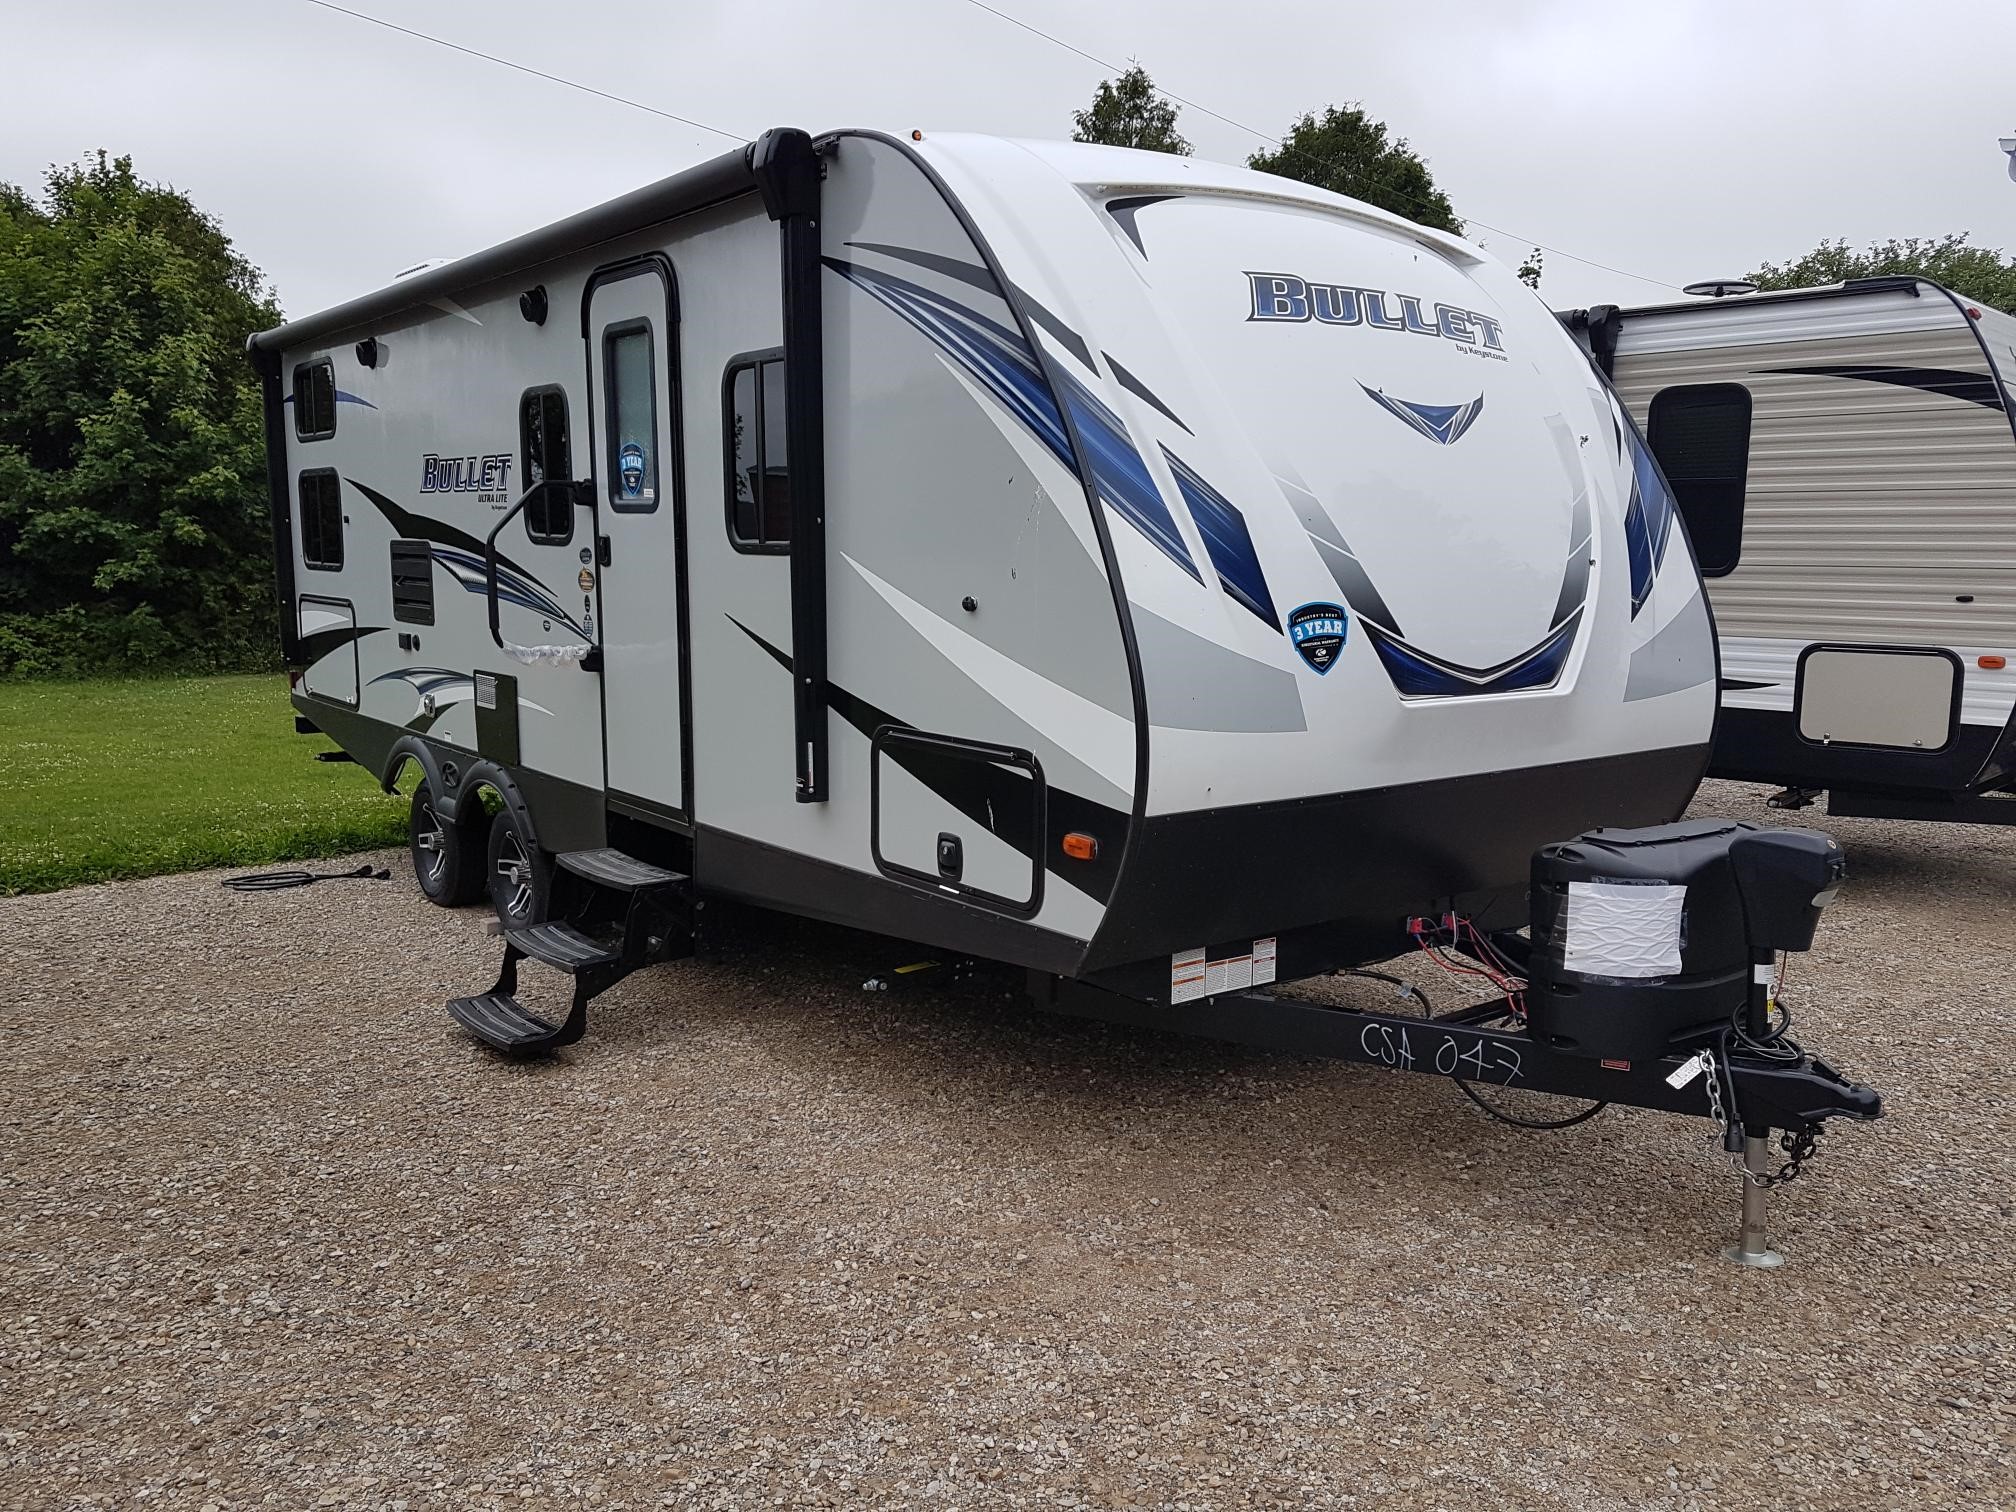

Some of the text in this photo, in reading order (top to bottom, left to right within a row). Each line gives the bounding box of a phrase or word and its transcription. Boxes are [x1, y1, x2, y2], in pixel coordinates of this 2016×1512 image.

[1241, 271, 1506, 353] BULLET
[1456, 344, 1509, 362] by Keystone
[420, 453, 513, 493] BULLET
[478, 494, 508, 503] ULTRA LITE
[1294, 620, 1343, 640] 3 YEAR
[1361, 1023, 1416, 1070] CSA
